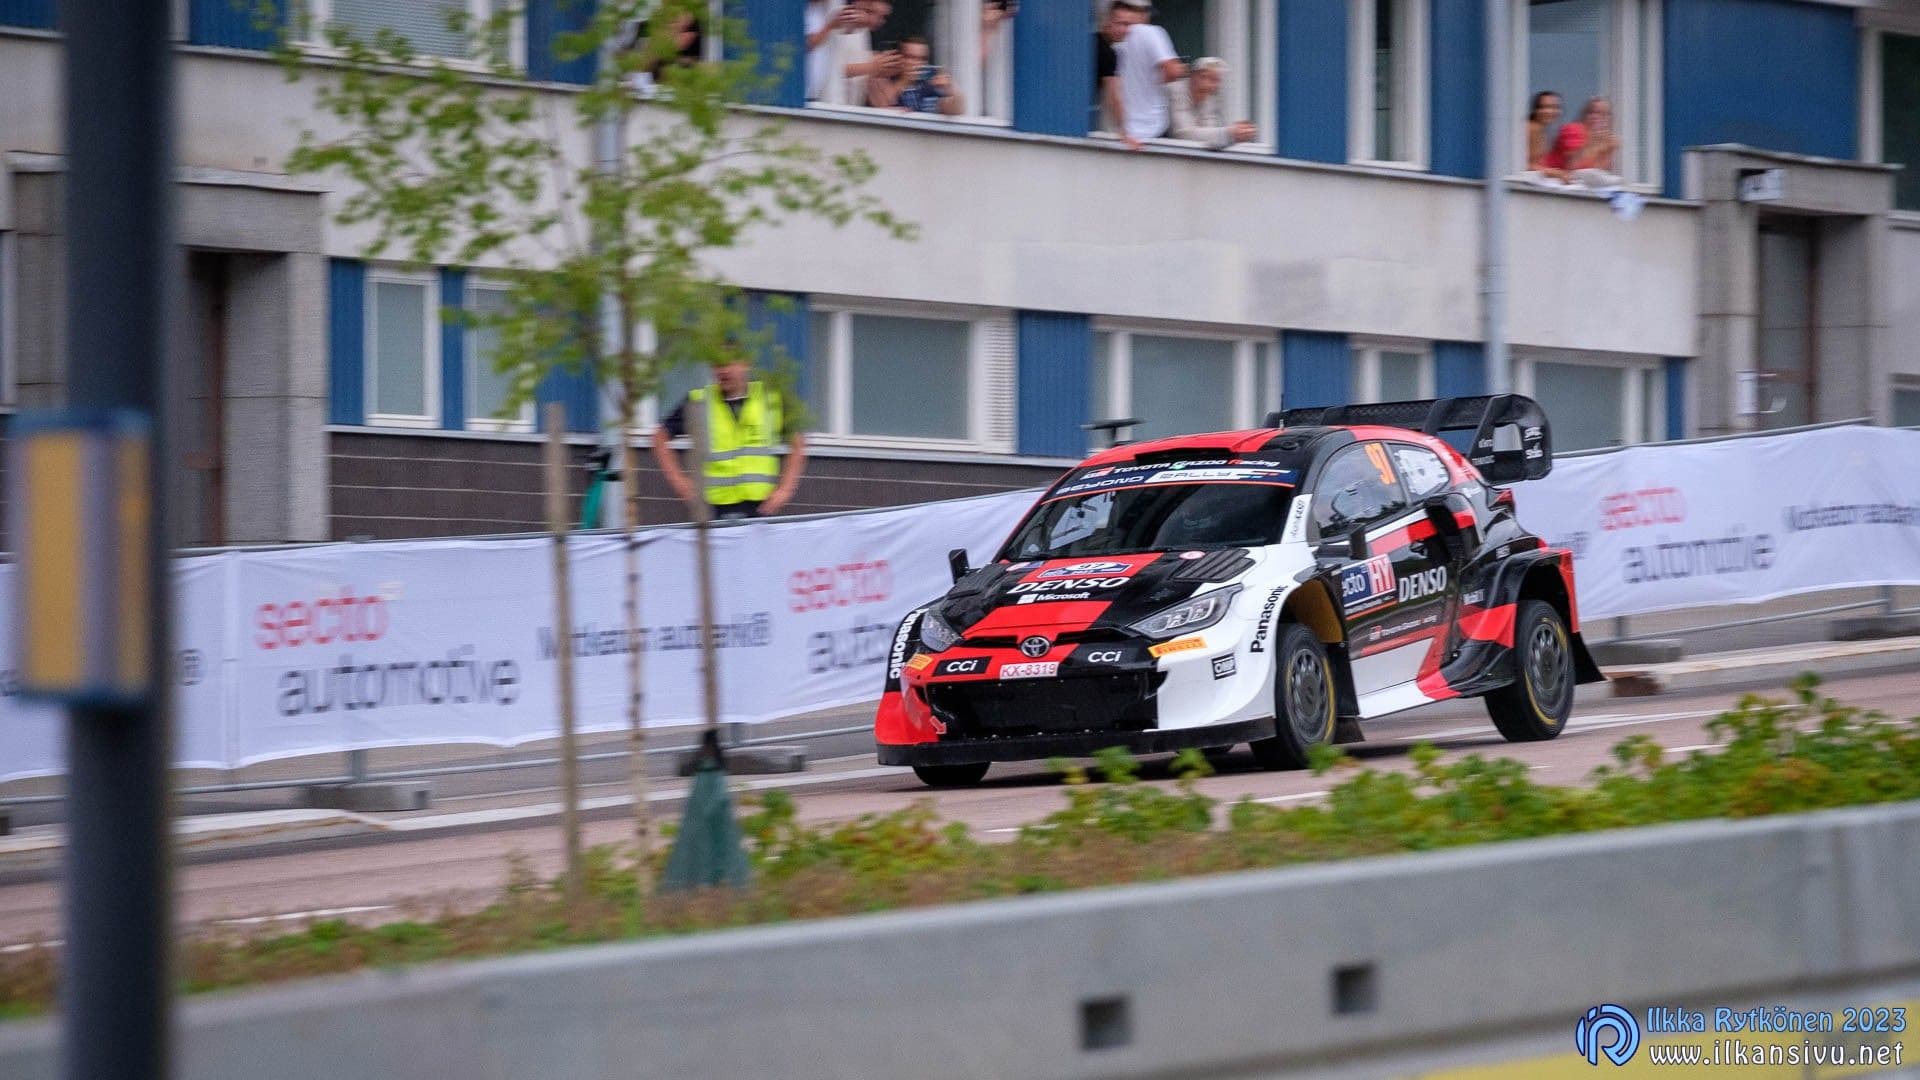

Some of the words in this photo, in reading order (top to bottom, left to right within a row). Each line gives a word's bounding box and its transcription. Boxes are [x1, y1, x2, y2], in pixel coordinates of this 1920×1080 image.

[1228, 459, 1281, 467] Racing
[1364, 443, 1396, 485] 97
[1056, 475, 1144, 495] BEYOND
[1006, 577, 1130, 594] DENSO
[1399, 566, 1447, 602] DENSO
[1037, 591, 1091, 601] Microsoft
[1250, 585, 1288, 653] Panasonic
[1001, 662, 1057, 678] KX-8319
